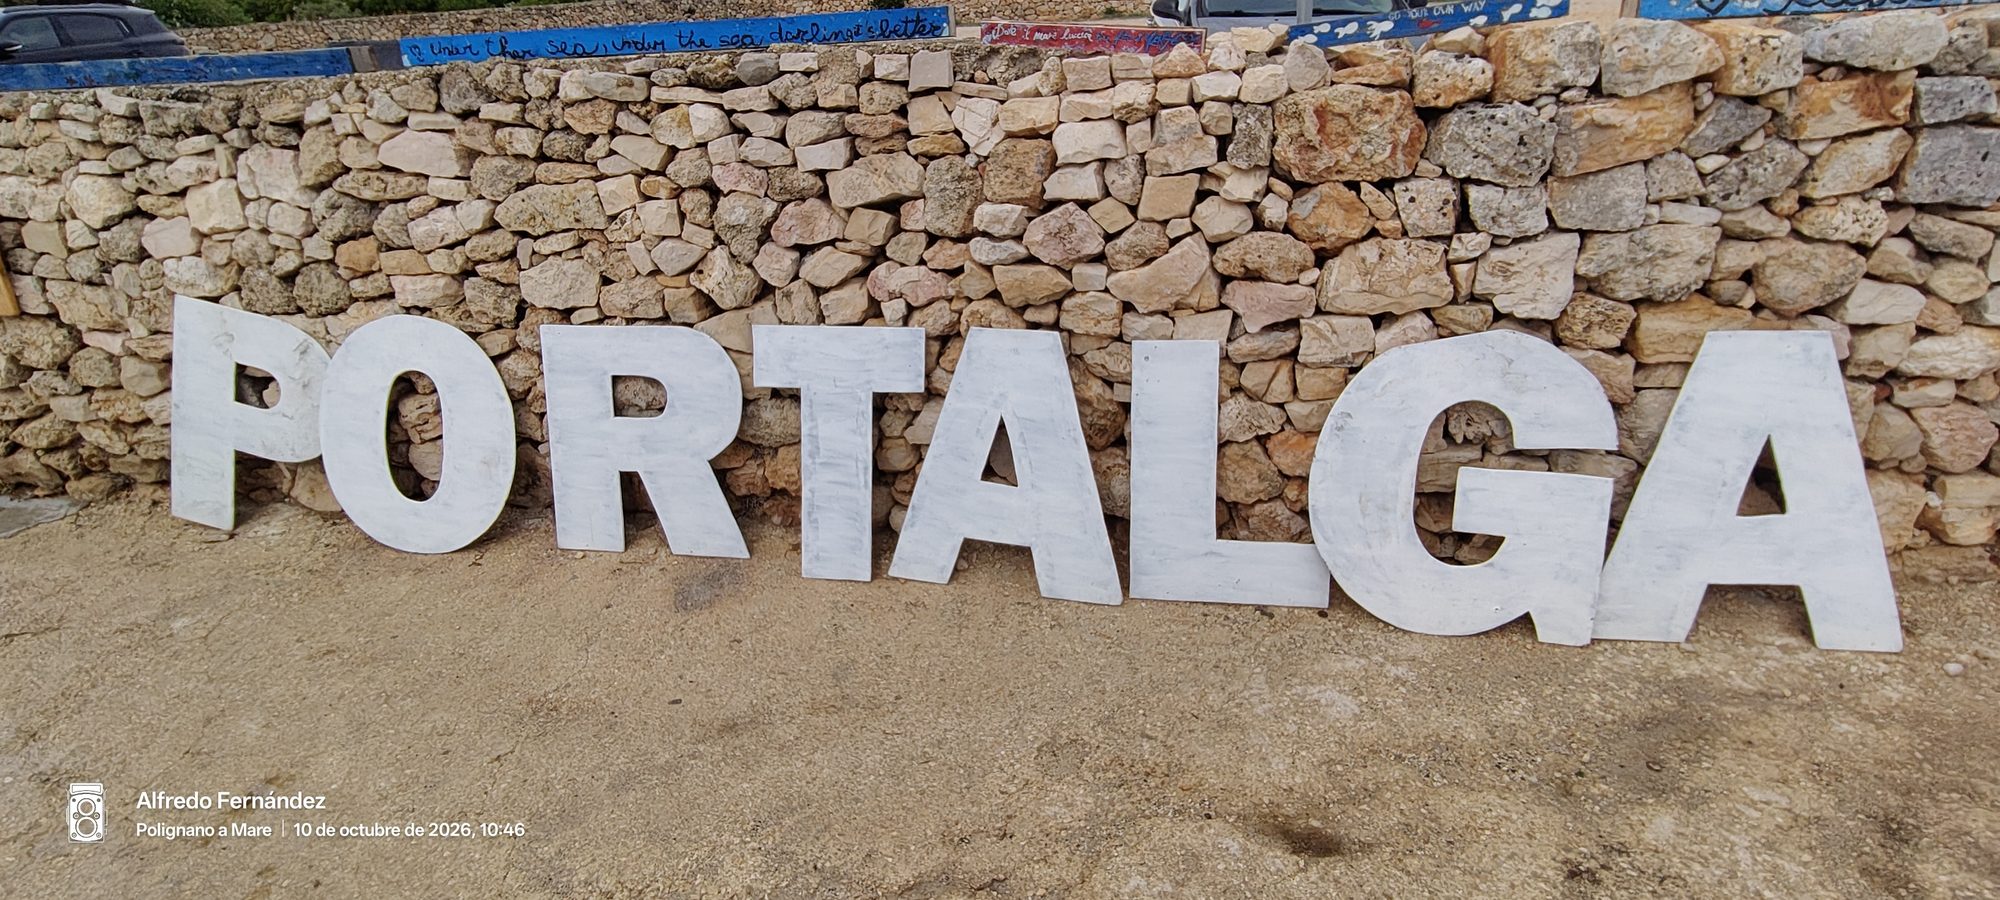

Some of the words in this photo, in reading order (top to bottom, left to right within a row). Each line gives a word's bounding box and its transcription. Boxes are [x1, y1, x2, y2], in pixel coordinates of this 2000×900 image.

[1388, 12, 1400, 21] GO
[1433, 6, 1455, 16] OWN
[1461, 0, 1485, 13] WAY
[674, 28, 712, 48] the
[877, 11, 943, 38] better
[171, 294, 1902, 652] PORTALGA
